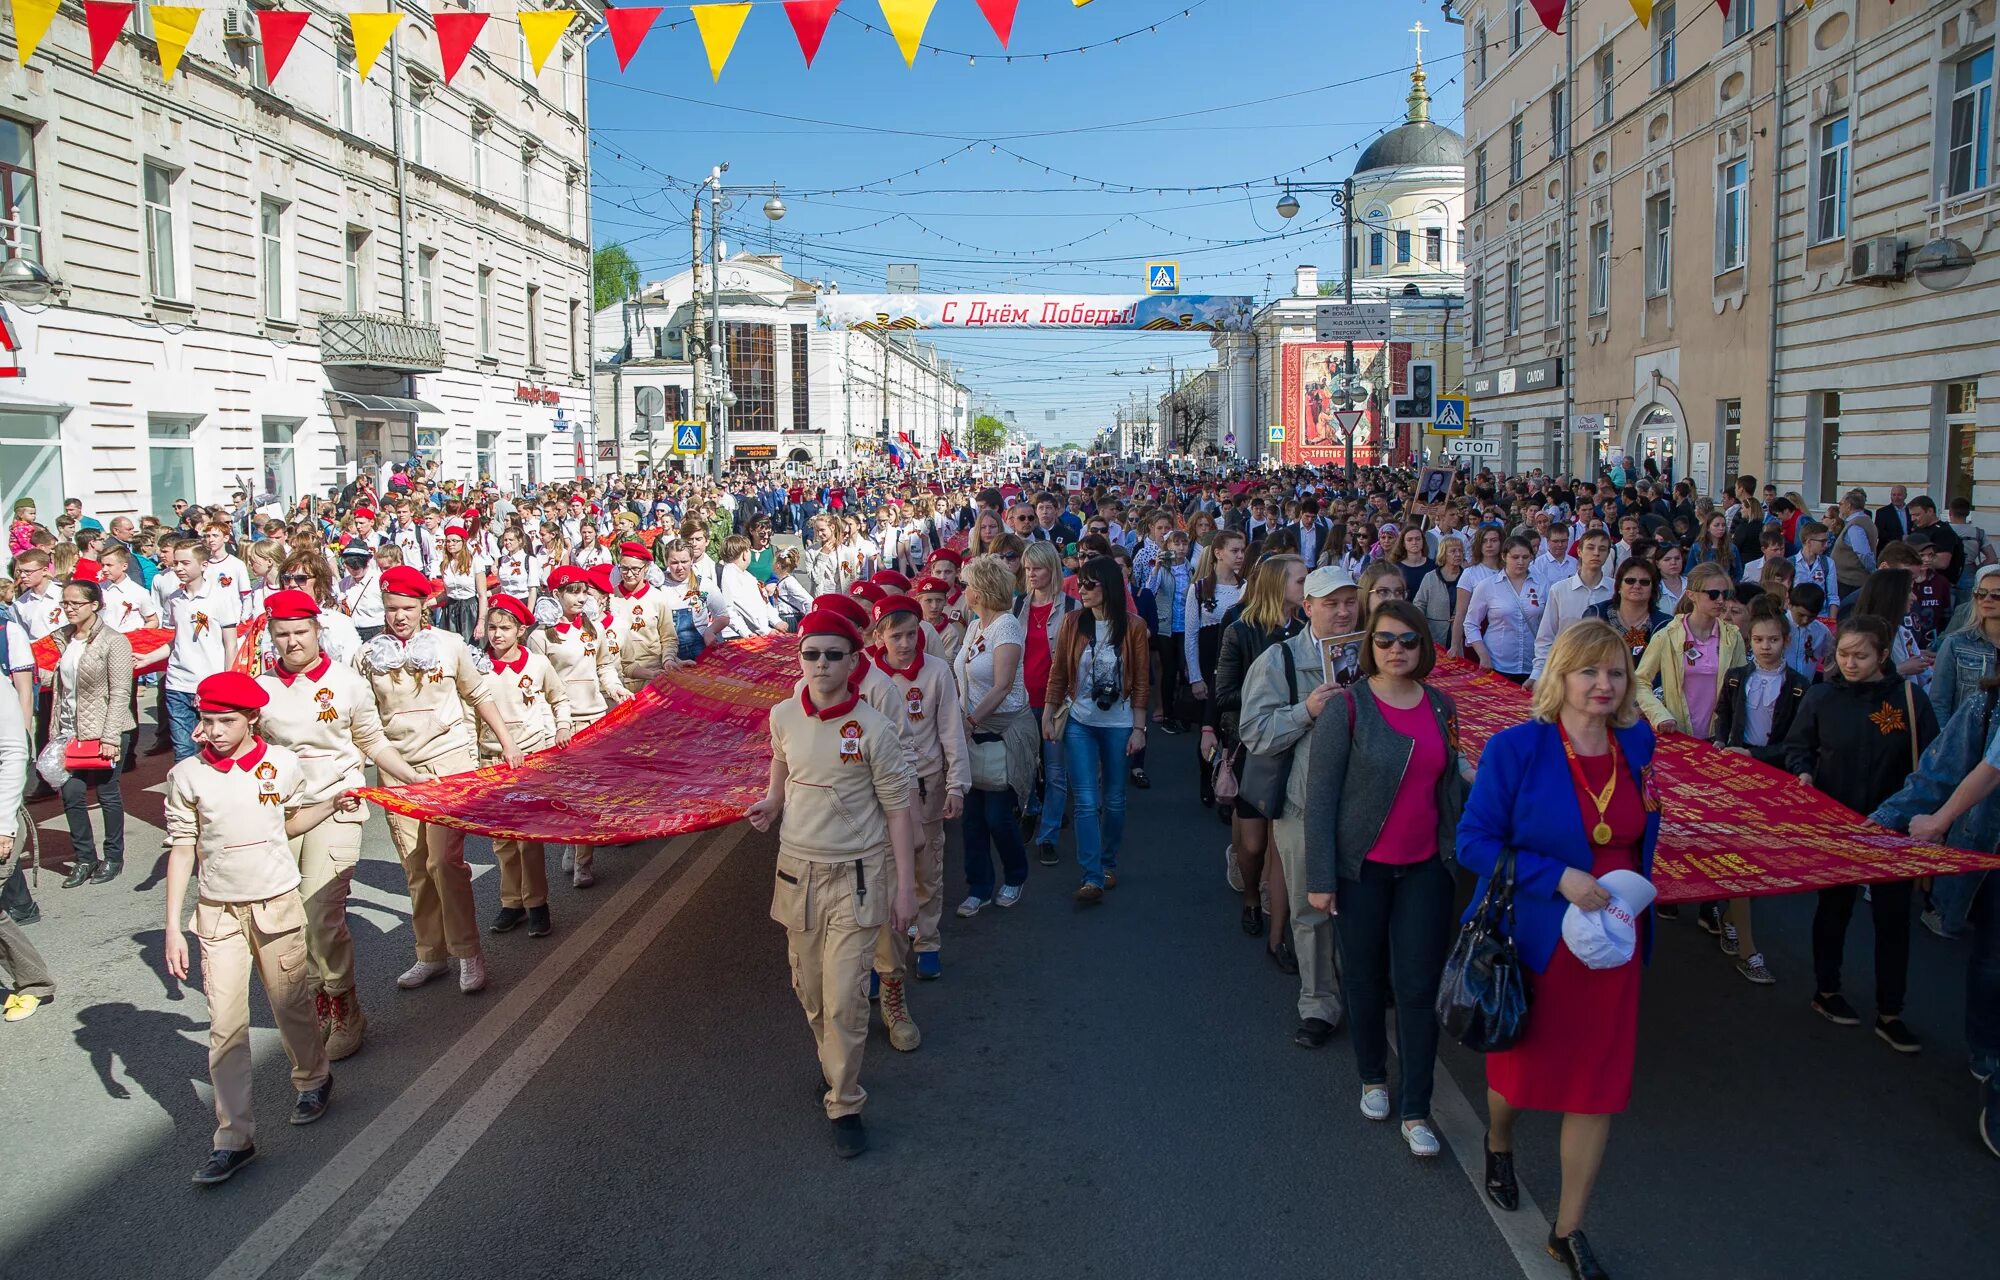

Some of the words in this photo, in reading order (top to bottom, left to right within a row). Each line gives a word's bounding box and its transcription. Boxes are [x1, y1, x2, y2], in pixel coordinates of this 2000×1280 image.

[941, 301, 958, 323] С
[965, 301, 1030, 326] Днём
[1039, 301, 1139, 326] Победы!
[1526, 368, 1545, 384] САЛОН
[1475, 379, 1490, 393] САЛОН
[1454, 441, 1493, 453] СТОП
